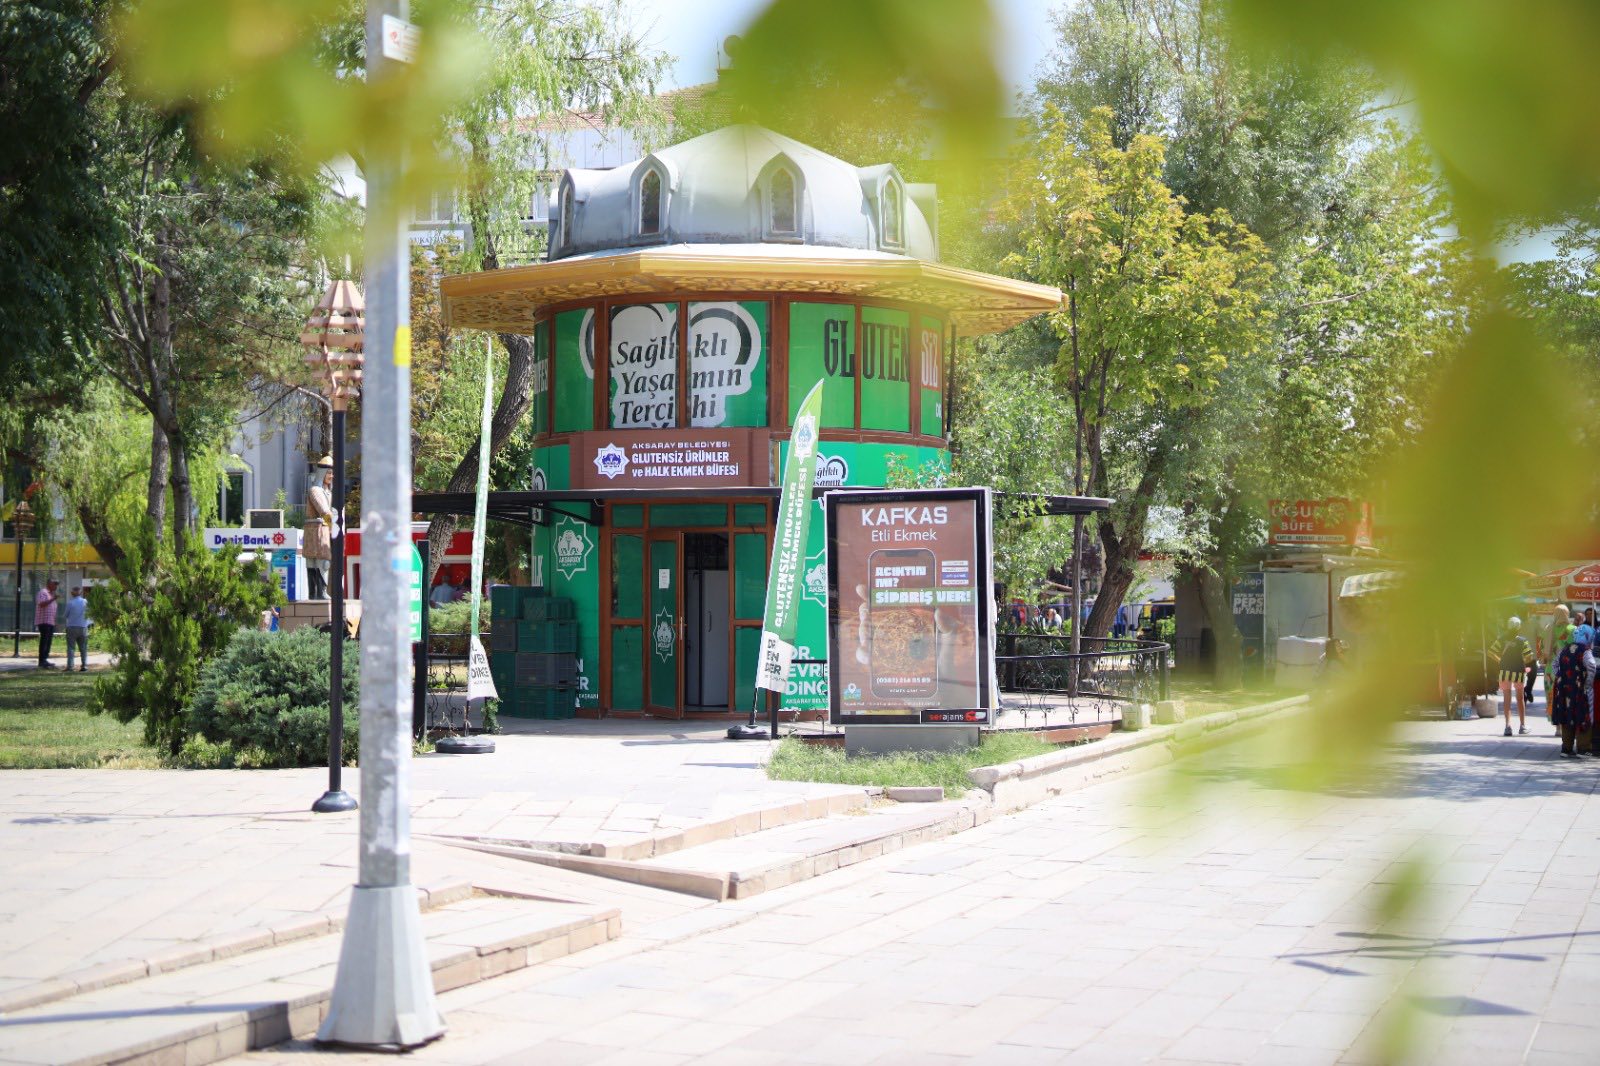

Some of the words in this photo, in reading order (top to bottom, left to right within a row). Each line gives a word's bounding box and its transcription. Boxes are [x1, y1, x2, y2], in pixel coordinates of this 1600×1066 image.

[631, 451, 684, 465] GLUTENSİZ
[685, 450, 729, 463] ÜRÜNLER
[631, 468, 643, 477] ve
[644, 466, 670, 477] HALK
[671, 465, 705, 477] EKMEK
[706, 462, 738, 476] BÜFESİ
[861, 506, 948, 526] KAFKAS
[871, 529, 891, 542] Etli
[894, 528, 937, 541] Ekmek
[936, 591, 971, 603] VER!
